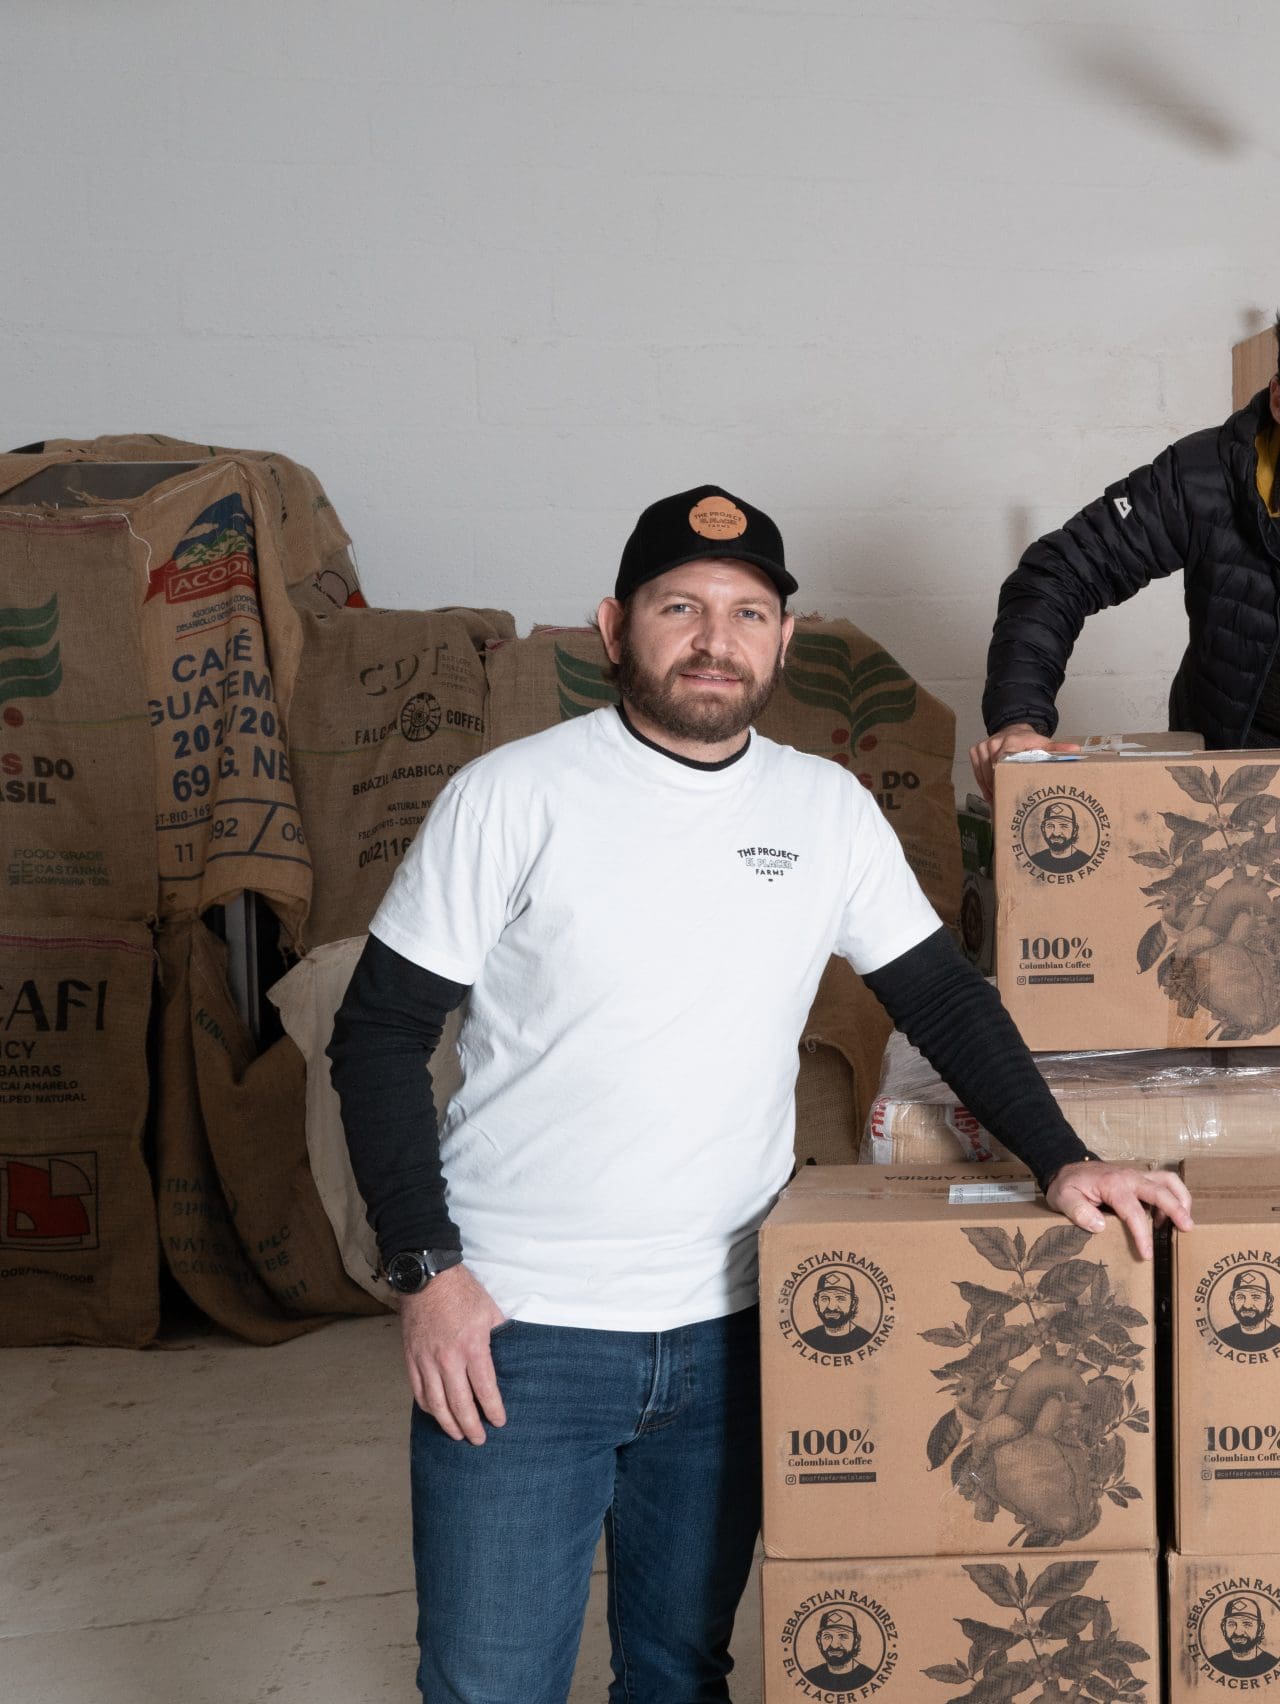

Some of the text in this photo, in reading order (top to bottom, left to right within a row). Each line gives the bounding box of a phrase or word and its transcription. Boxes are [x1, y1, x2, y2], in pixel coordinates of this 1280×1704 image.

[174, 560, 250, 595] ACODI
[147, 671, 274, 727] GUATEM
[32, 755, 75, 782] DO
[172, 764, 211, 802] 69
[253, 746, 292, 782] NE
[352, 774, 391, 797] BRAZIL
[391, 763, 445, 782] ARABICA
[881, 769, 921, 791] DO
[1010, 784, 1112, 832] SEBASTIAN RAMIREZ
[737, 846, 800, 862] THE PROJECT
[755, 868, 785, 876] FARMS
[1011, 839, 1111, 885] EL PLACER FARMS
[1019, 936, 1093, 960] 100%
[1019, 960, 1091, 970] Colombian Coffee
[4, 977, 109, 1032] AFI
[1, 1039, 37, 1060] CY
[778, 1250, 896, 1306] SEBASTIAN RAMIREZ
[1194, 1249, 1259, 1304] SEBASTIAN
[779, 1314, 896, 1367] EL PLACER FARMS
[1195, 1317, 1209, 1337] EL
[1207, 1337, 1269, 1365] PLACER
[787, 1428, 875, 1456] 100%
[787, 1456, 873, 1467] Colombian Coffee
[1203, 1453, 1255, 1463] Colombian
[780, 1588, 898, 1644] SEBASTIAN RAMIREZ
[1186, 1577, 1250, 1631] SEBASTIAN
[782, 1651, 899, 1704] EL PLACER FARMS
[1187, 1643, 1201, 1663] EL
[1199, 1662, 1261, 1690] PLACER
